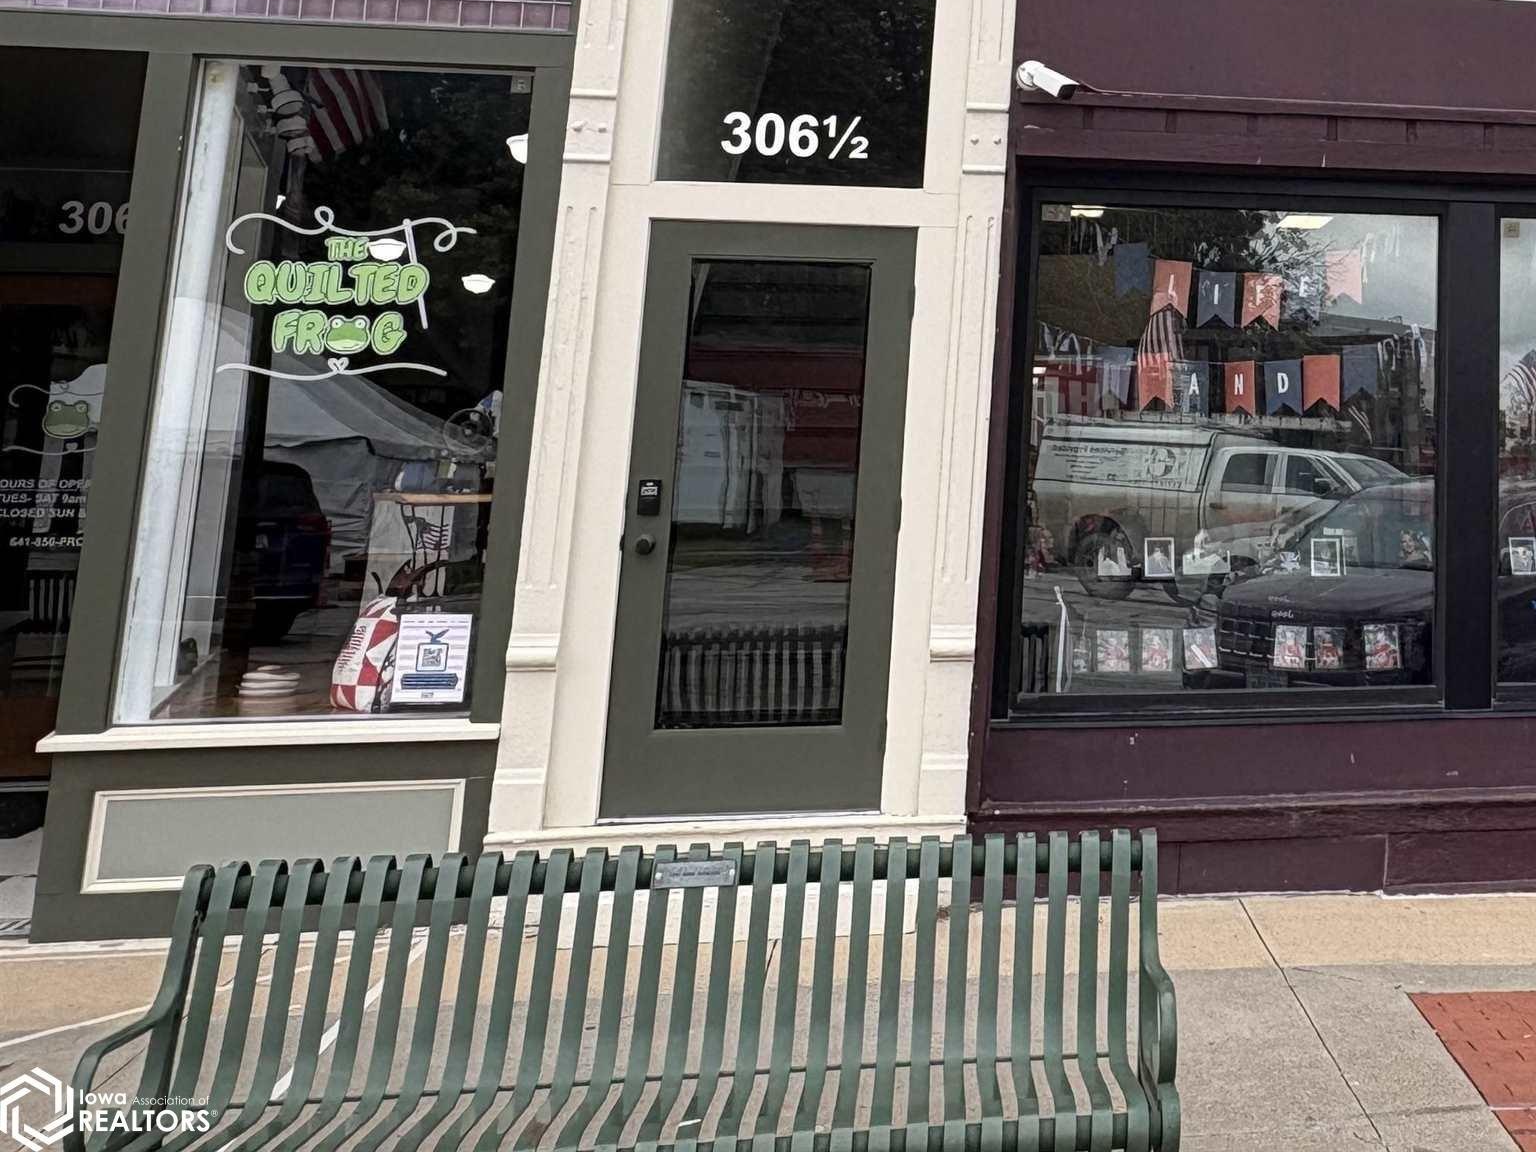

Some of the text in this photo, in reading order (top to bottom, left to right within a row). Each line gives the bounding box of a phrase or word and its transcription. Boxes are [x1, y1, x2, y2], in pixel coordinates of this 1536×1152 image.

[325, 236, 369, 262] THE
[244, 260, 430, 305] QUILTED
[1188, 372, 1290, 396] AND
